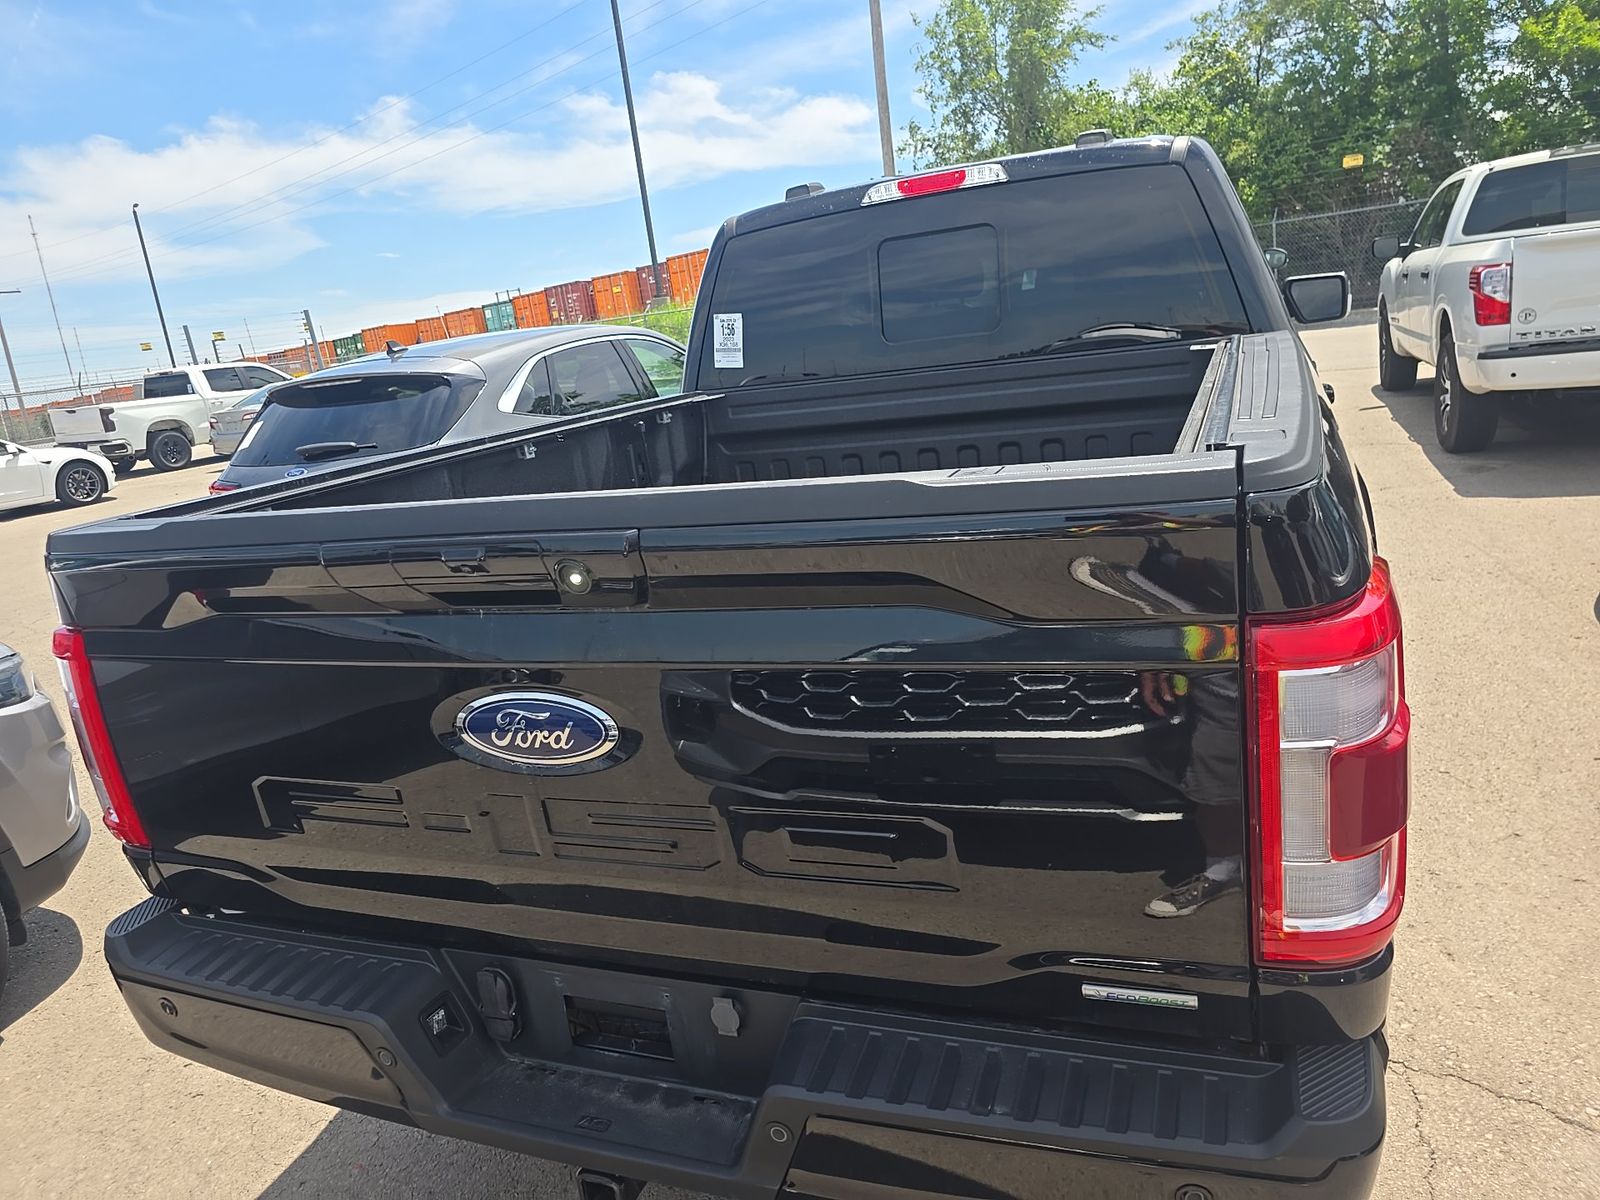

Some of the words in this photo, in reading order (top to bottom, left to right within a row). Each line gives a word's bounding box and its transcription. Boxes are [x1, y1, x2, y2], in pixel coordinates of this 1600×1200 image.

[1516, 326, 1596, 339] TITAN
[491, 708, 575, 750] Ford
[252, 776, 960, 892] F-150
